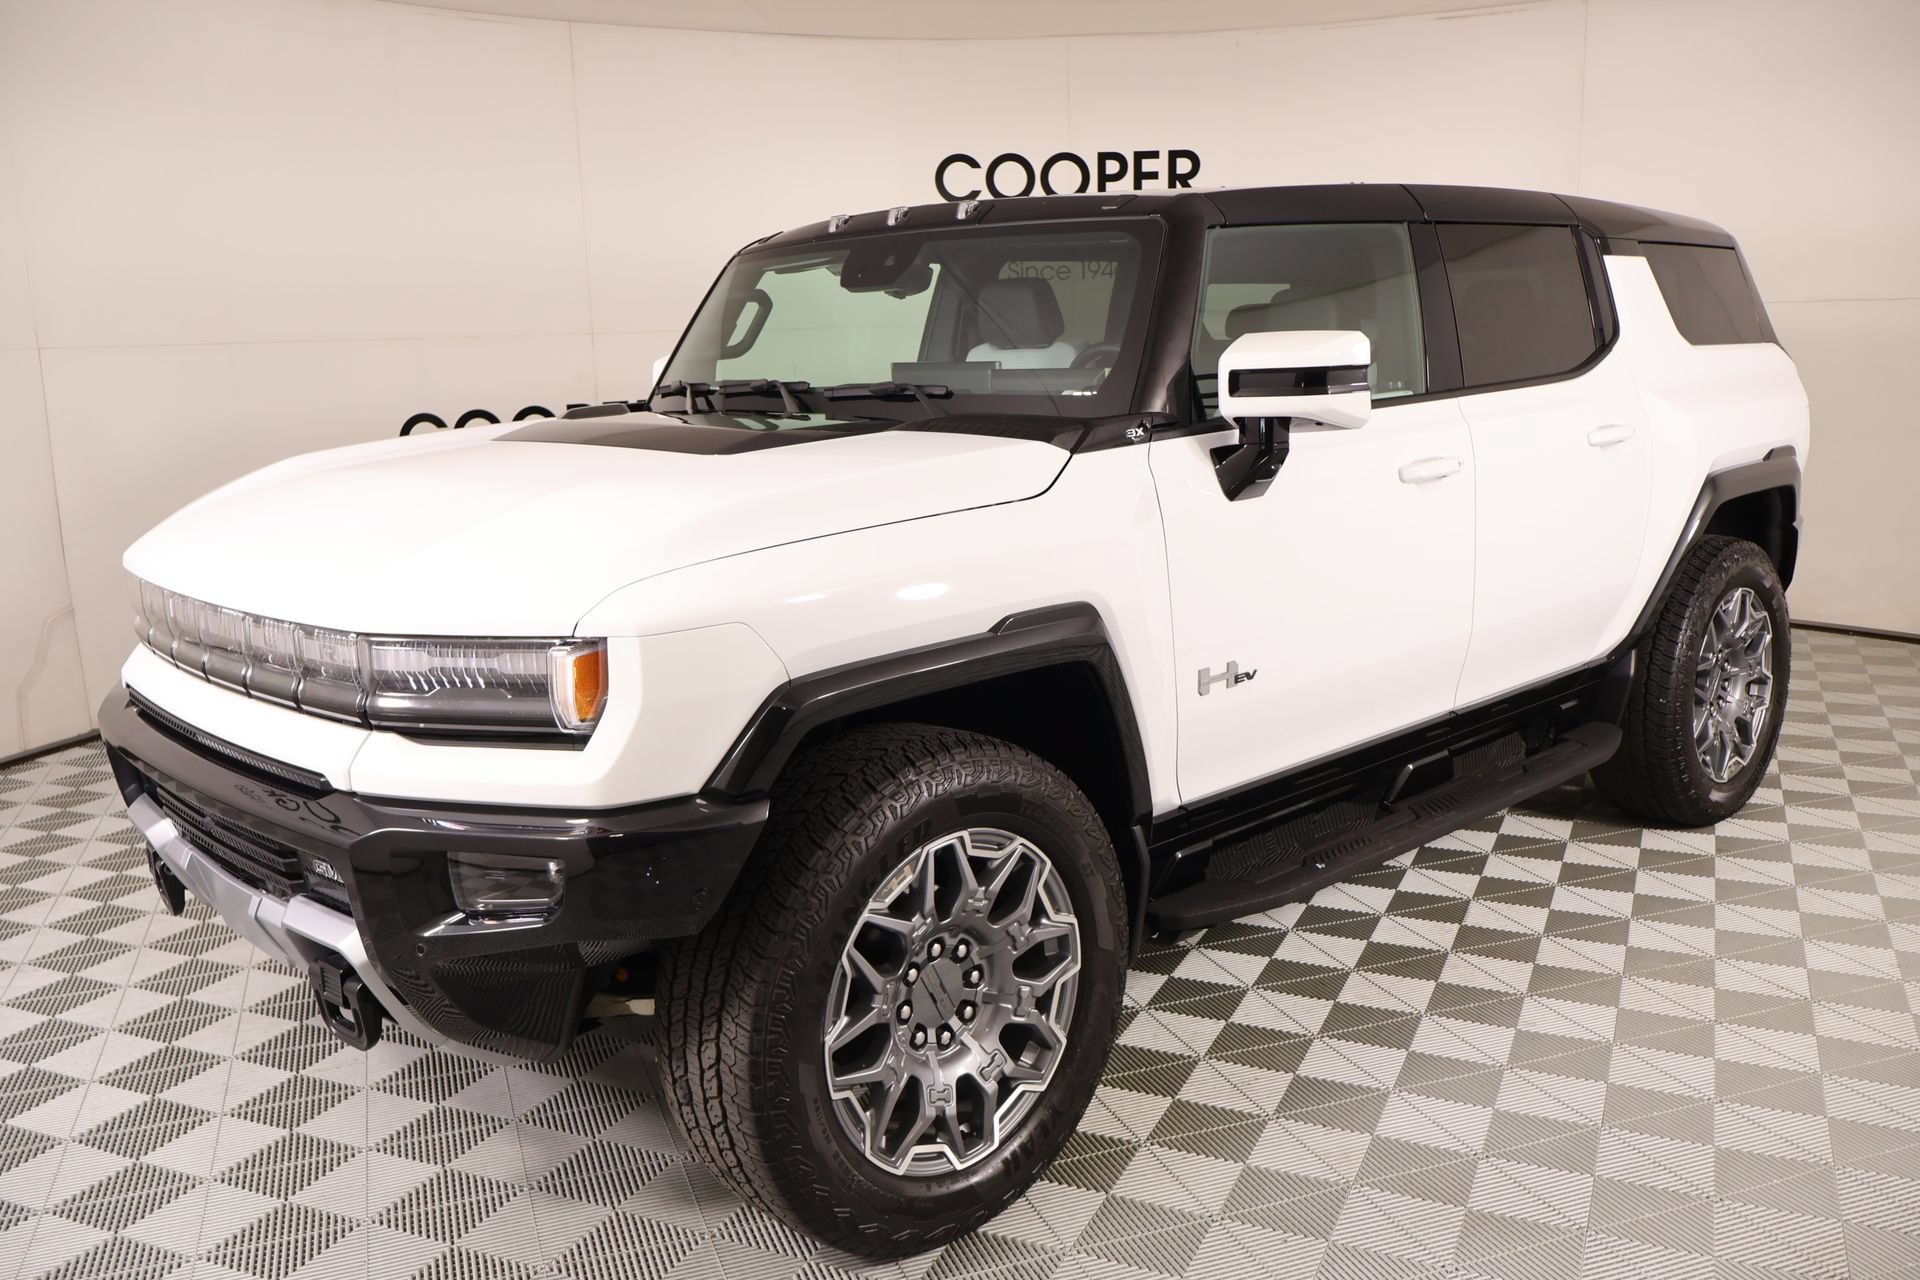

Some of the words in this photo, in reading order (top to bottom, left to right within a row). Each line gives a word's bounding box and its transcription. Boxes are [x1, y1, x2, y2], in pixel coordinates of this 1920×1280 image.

[935, 150, 1201, 203] COOPER
[1007, 259, 1072, 281] Since
[1081, 260, 1119, 280] 194
